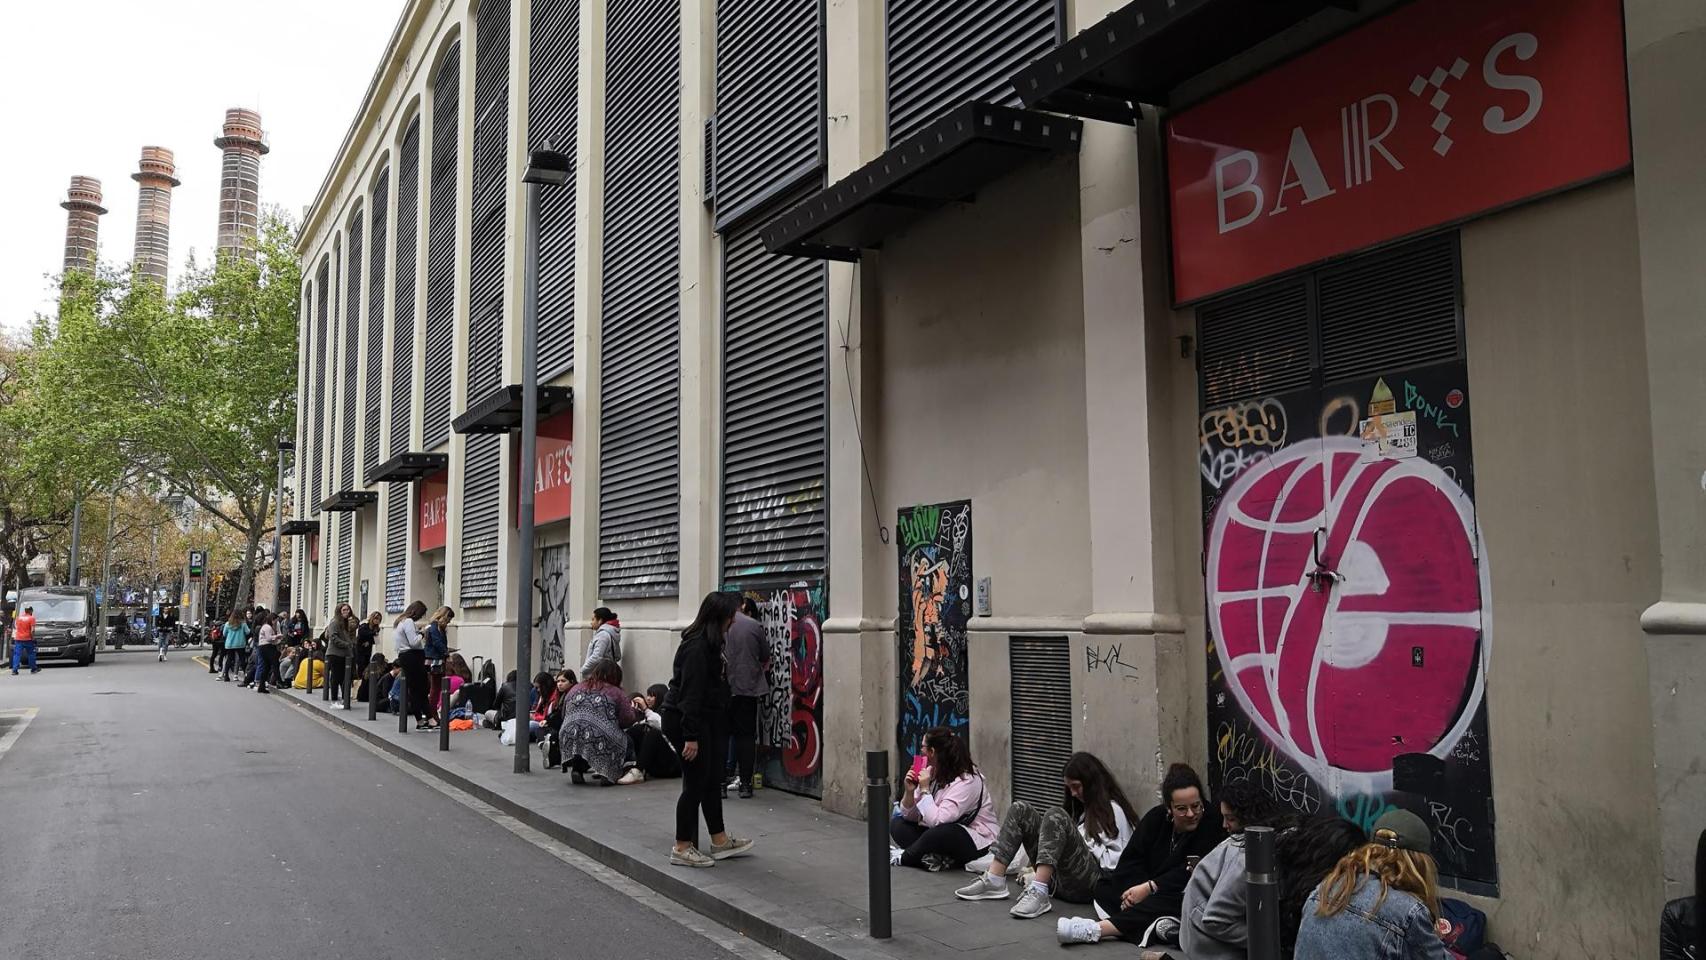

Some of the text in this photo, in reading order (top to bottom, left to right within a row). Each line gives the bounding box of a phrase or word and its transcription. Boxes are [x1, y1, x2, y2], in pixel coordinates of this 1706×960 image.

[1215, 31, 1544, 235] BARTS
[423, 495, 448, 529] BART
[191, 553, 202, 567] P
